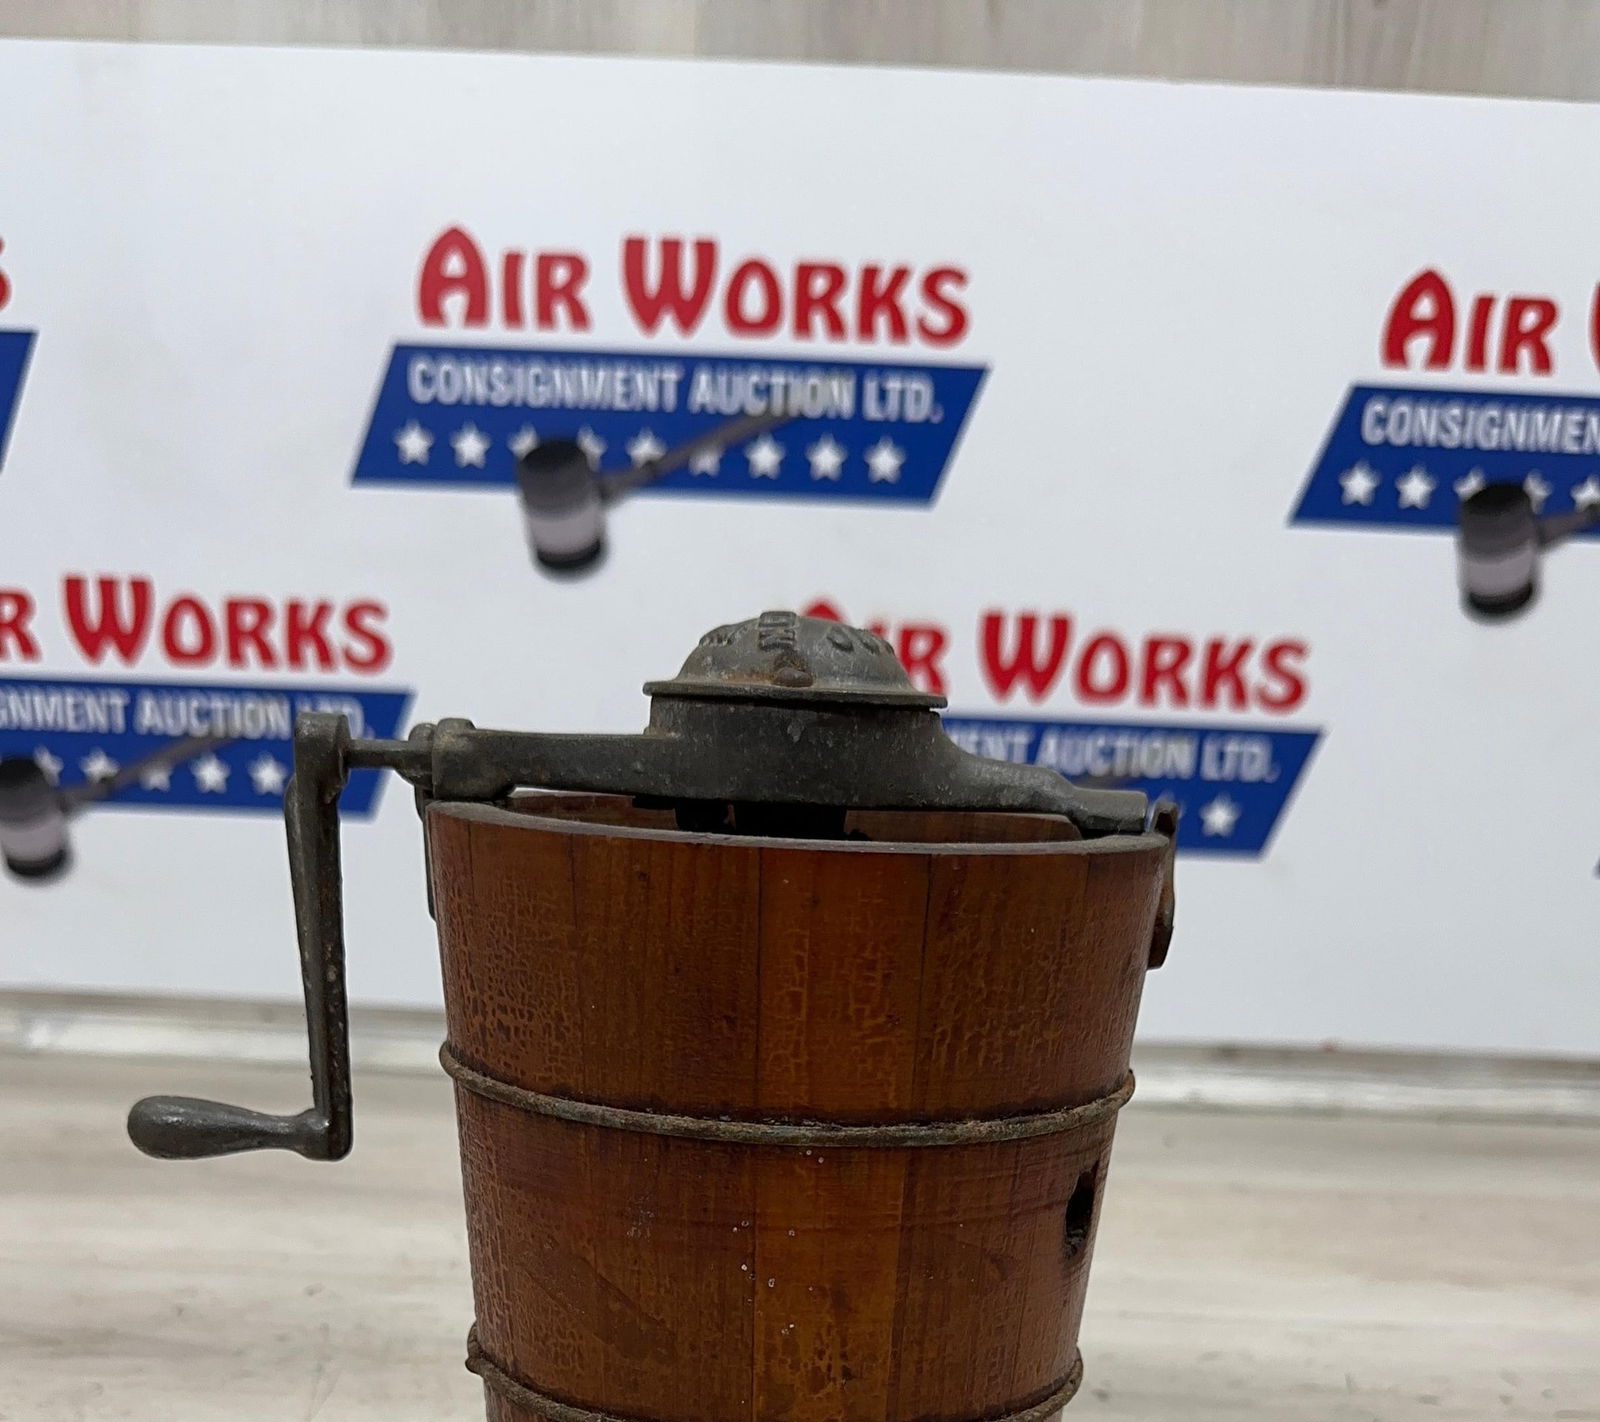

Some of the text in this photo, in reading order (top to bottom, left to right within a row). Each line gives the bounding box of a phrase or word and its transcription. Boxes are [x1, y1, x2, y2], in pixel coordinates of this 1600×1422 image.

[416, 225, 970, 348] AIR WORKS
[1380, 267, 1561, 376] AIR
[407, 355, 944, 424] CONSIGNMENT AUCTION LTD.
[62, 574, 393, 674] WORKS
[978, 610, 1309, 714] WORKS
[133, 687, 291, 740] AUCTION
[1035, 728, 1199, 779] AUCTION
